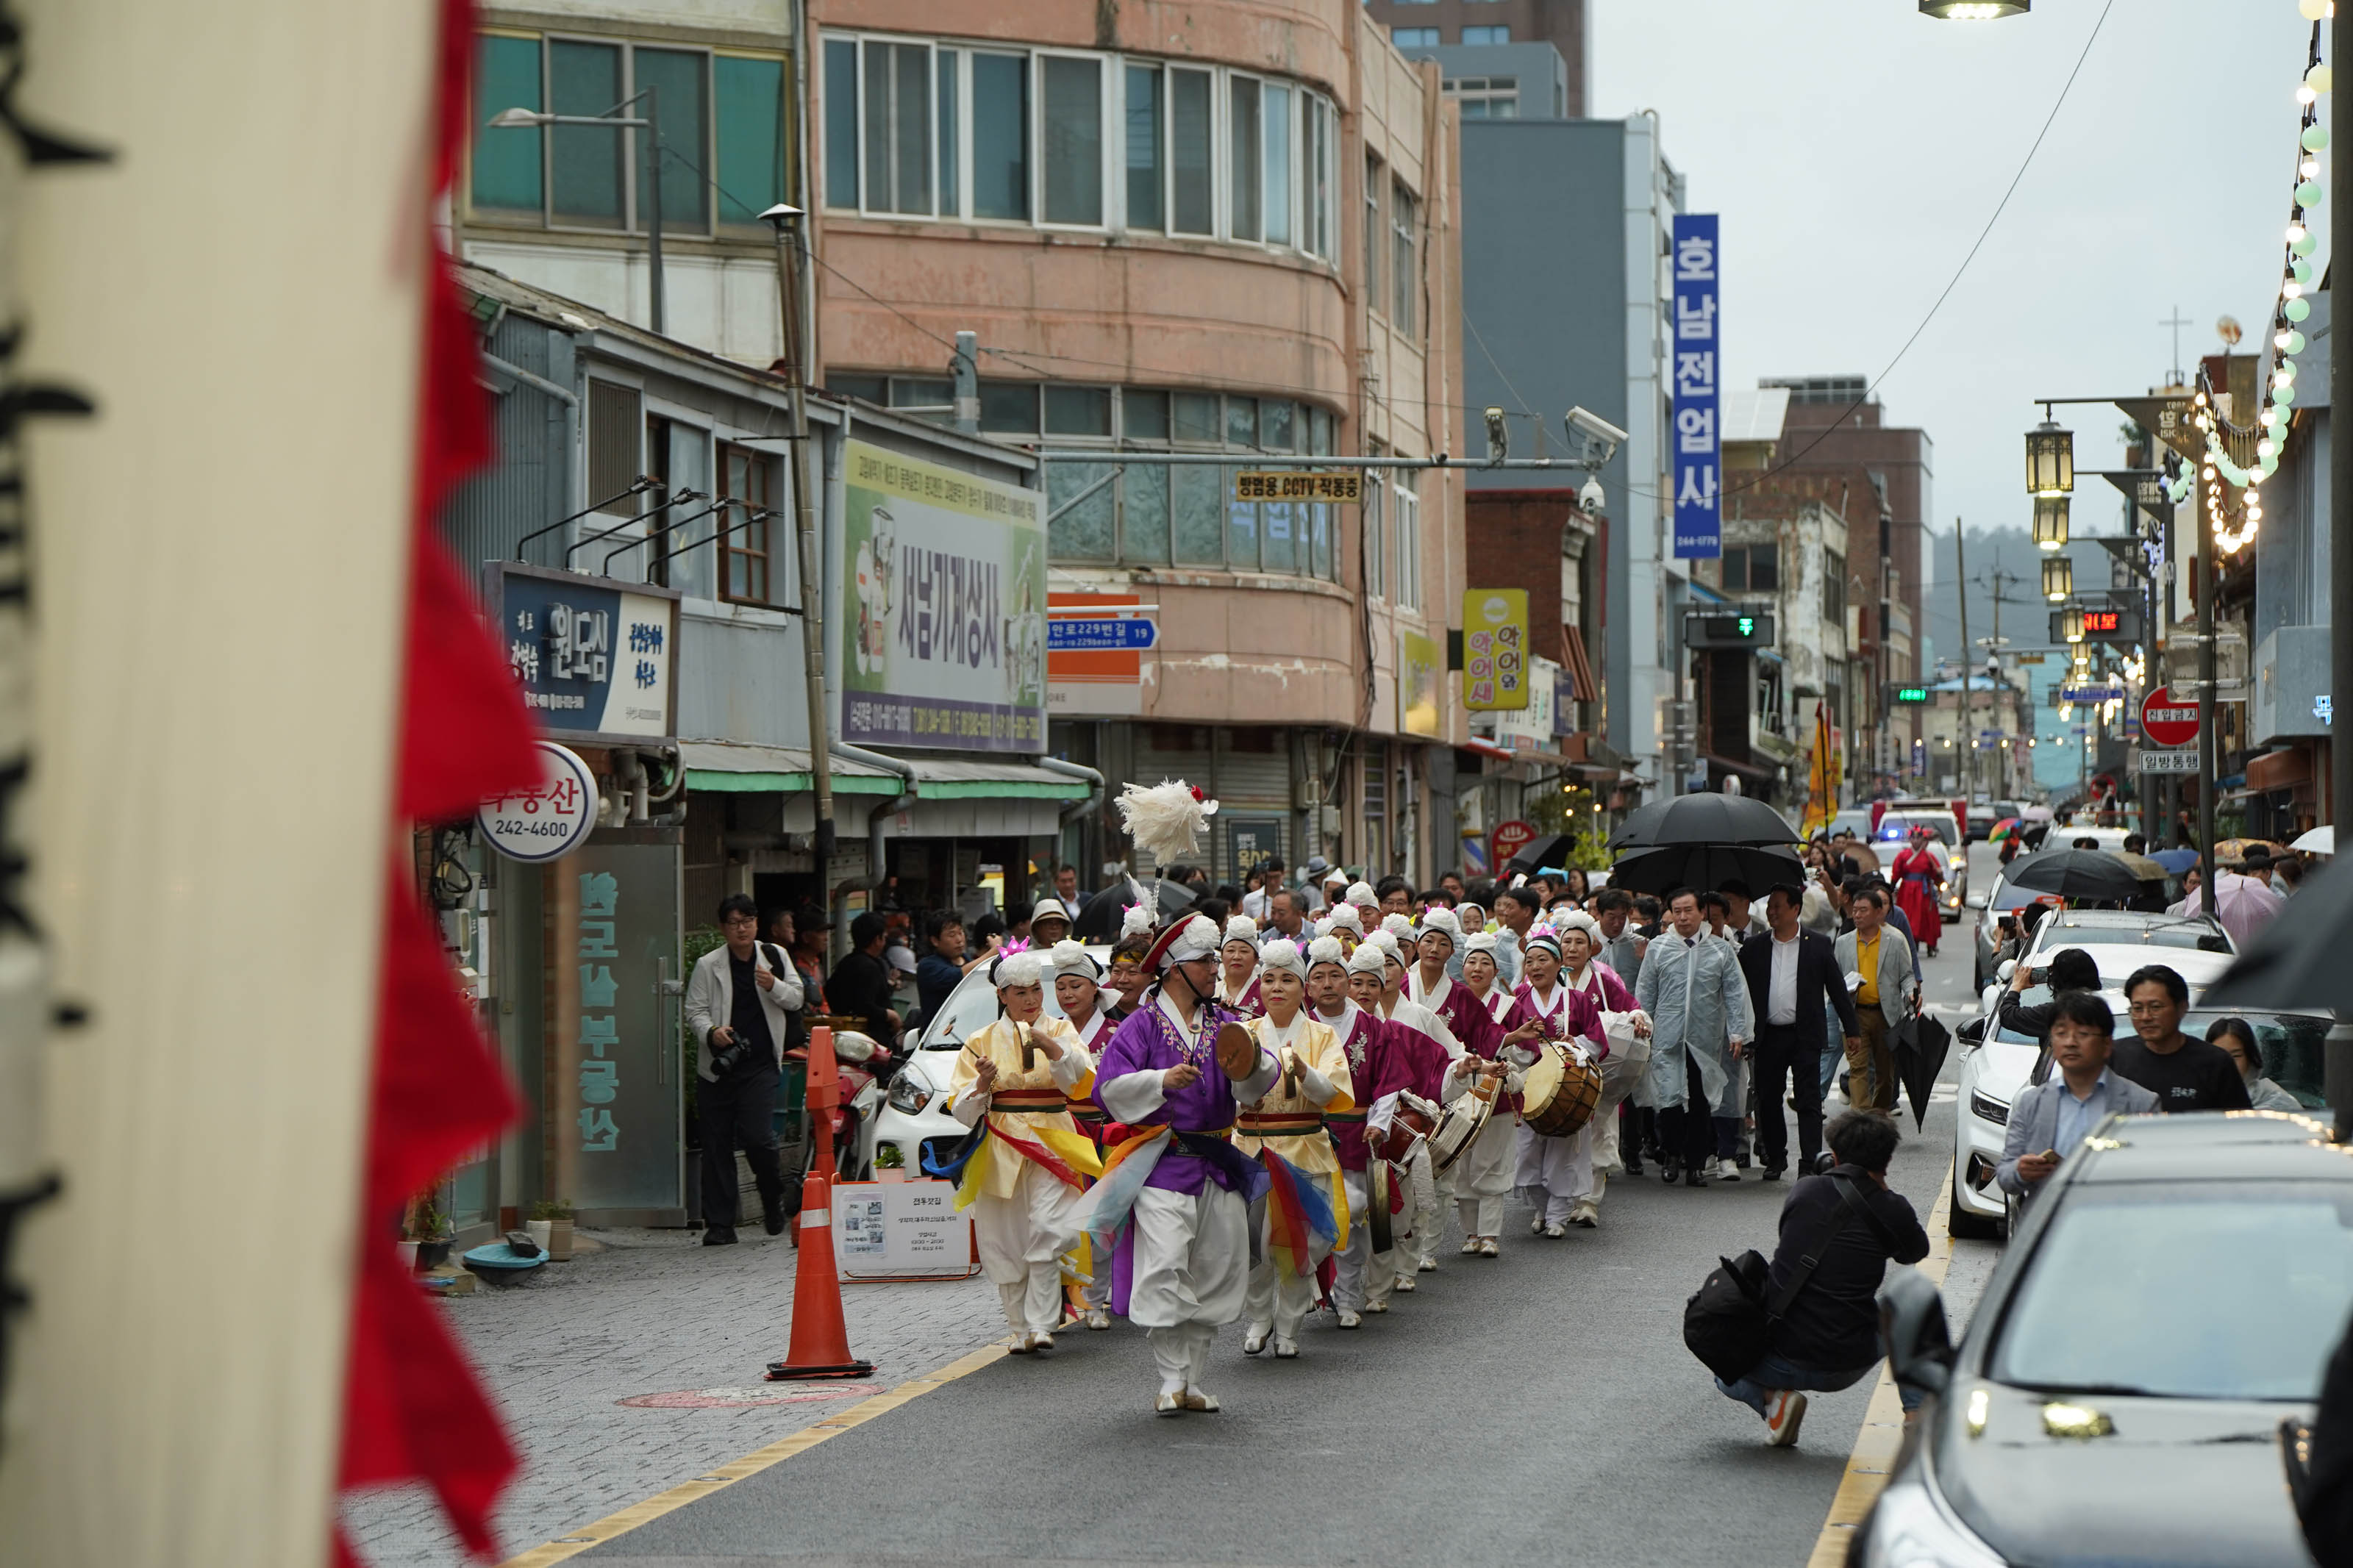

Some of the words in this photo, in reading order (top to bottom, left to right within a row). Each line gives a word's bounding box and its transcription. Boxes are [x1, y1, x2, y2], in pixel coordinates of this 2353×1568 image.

[1676, 236, 1718, 510] 호남전업사
[1240, 476, 1277, 497] 방범용
[1282, 477, 1315, 495] CCTV
[1320, 477, 1357, 498] 작동중
[900, 544, 999, 669] 서남기계상사
[549, 602, 609, 682] 원도심
[1047, 623, 1126, 637] 안로229번길
[1135, 628, 1148, 638] 19
[1469, 631, 1494, 704] 악어새
[1497, 625, 1520, 690] 악어와
[2147, 709, 2196, 721] 진입금지
[2146, 754, 2198, 770] 일방통행
[496, 820, 568, 837] 242-4600
